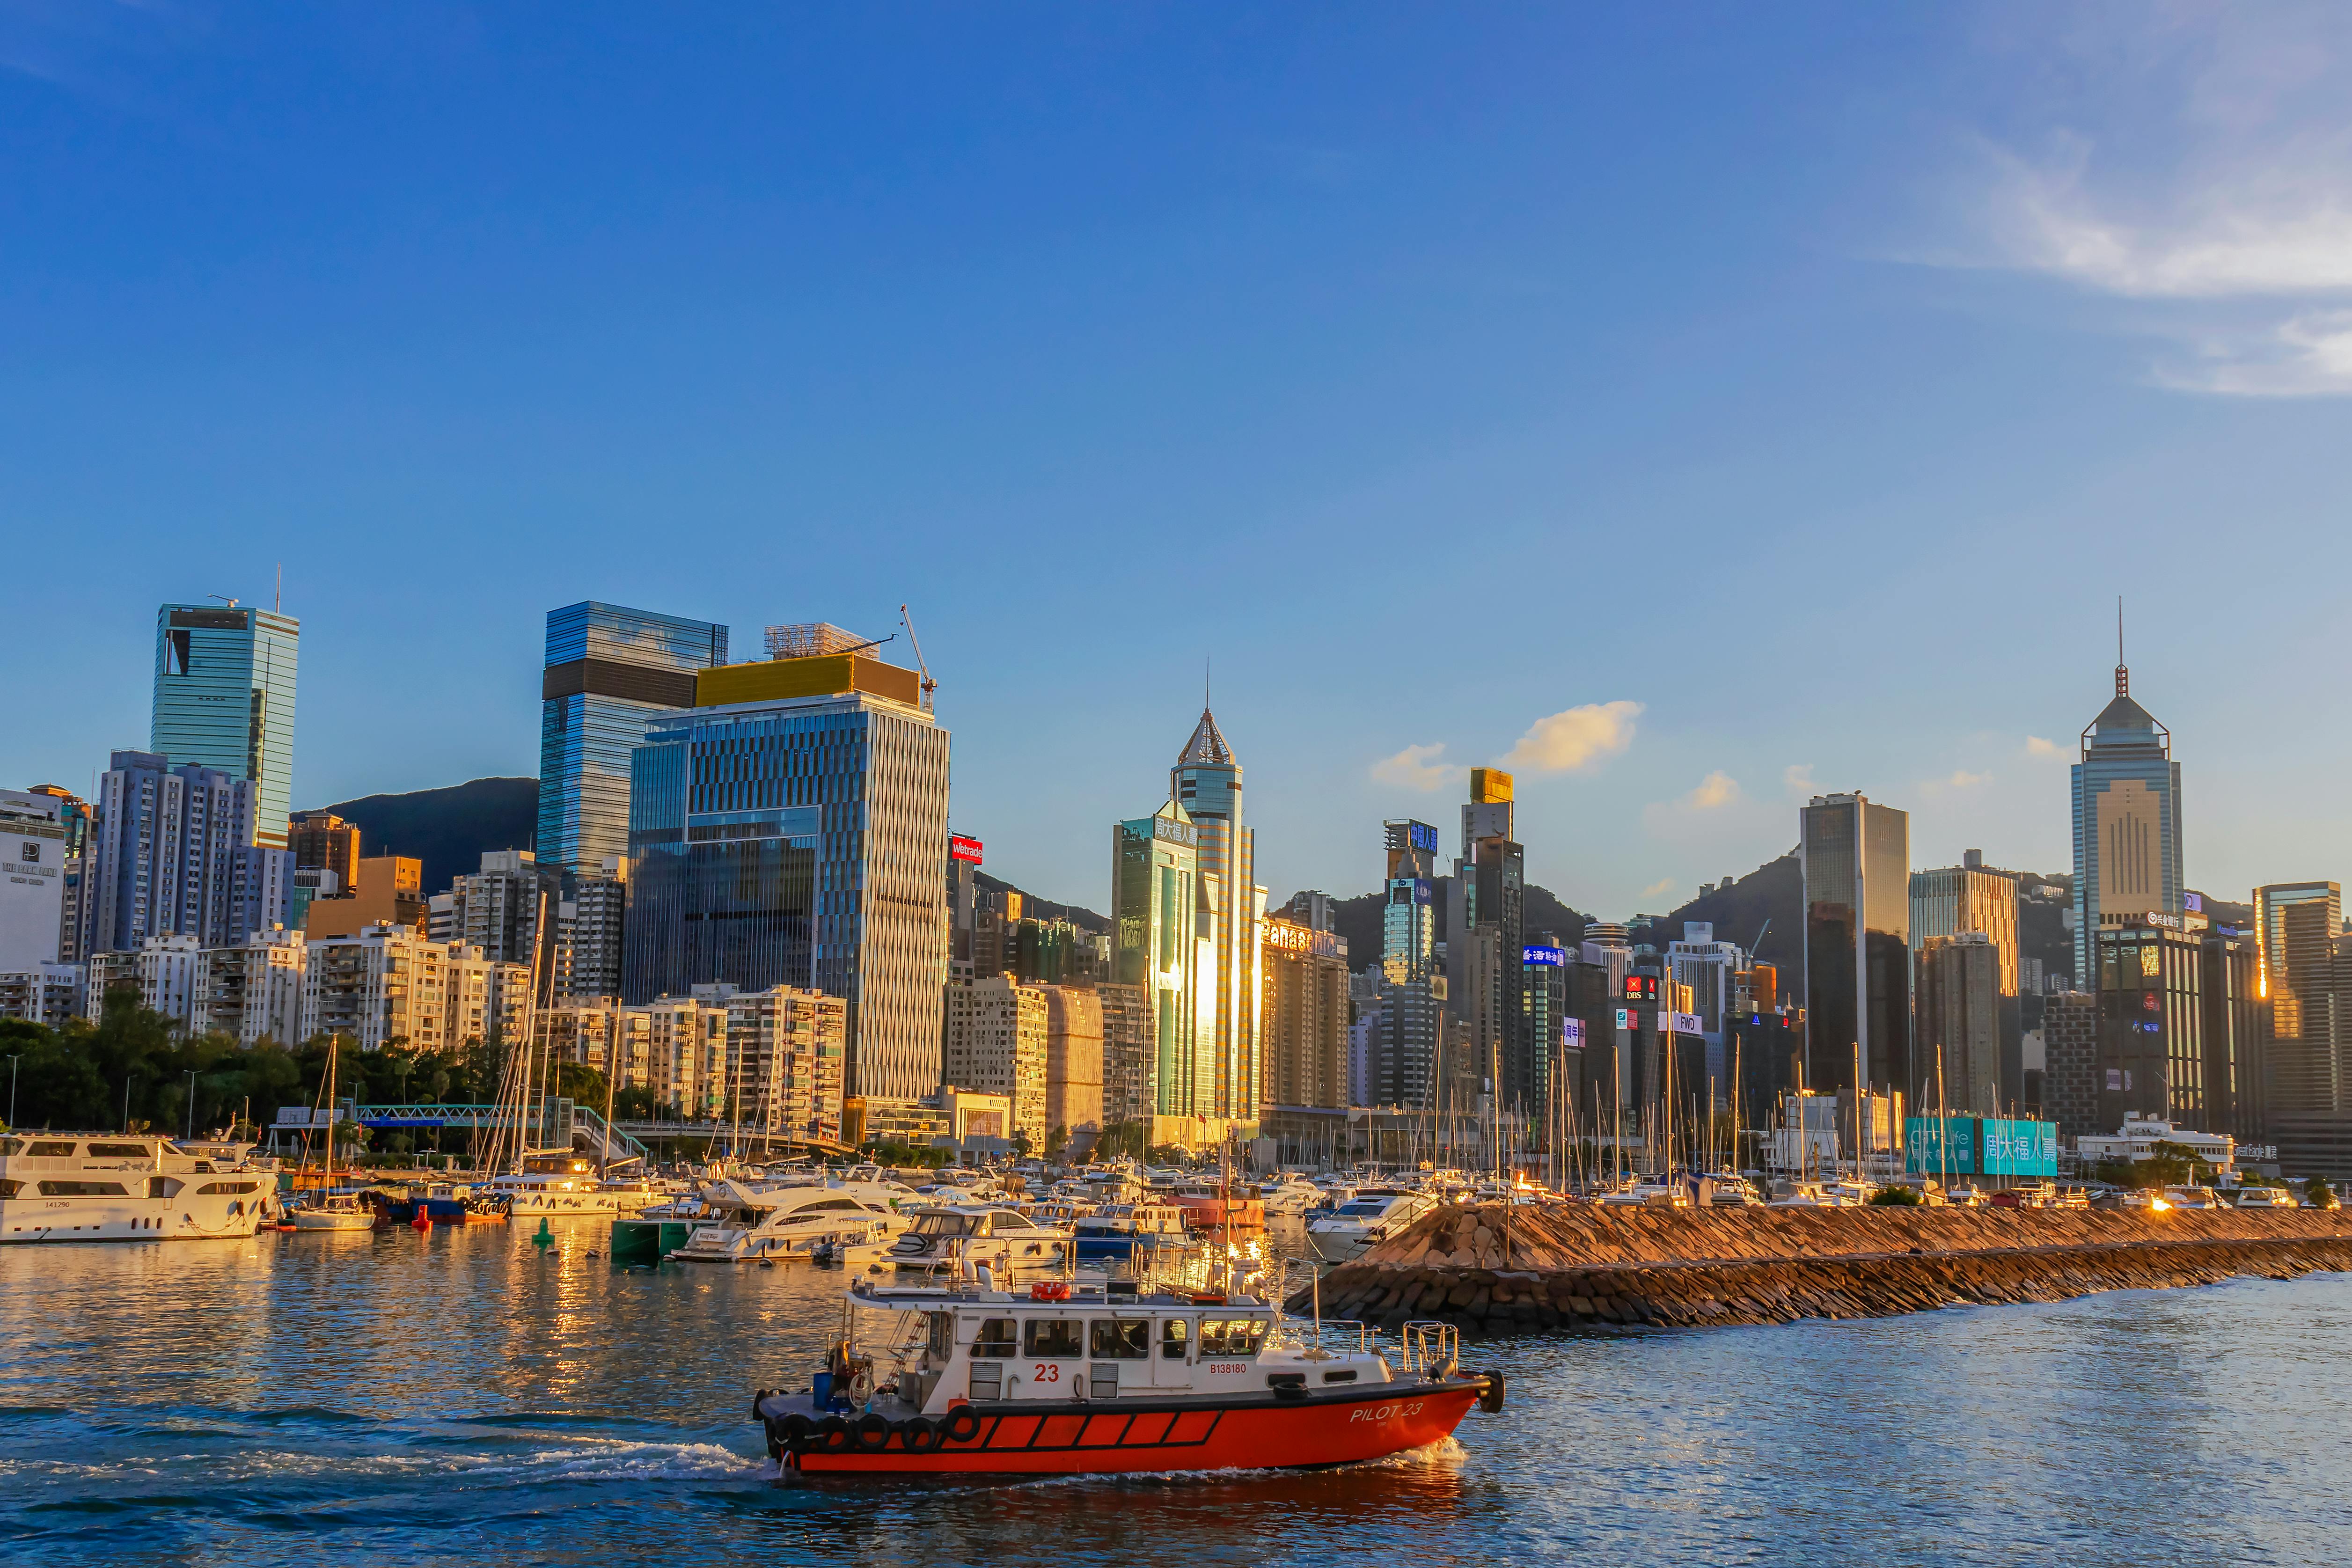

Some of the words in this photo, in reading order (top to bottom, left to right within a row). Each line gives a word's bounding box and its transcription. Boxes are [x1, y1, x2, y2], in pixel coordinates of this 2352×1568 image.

[1155, 818, 1198, 845] 周大福人壽
[1411, 822, 1437, 853] 中国人寿
[3, 863, 16, 872] THE
[19, 864, 37, 875] PARK
[39, 867, 57, 877] LANE
[1261, 916, 1335, 958] Panasonic
[1681, 1016, 1694, 1030] FWD
[1986, 1135, 2057, 1162] 周大福人壽
[1034, 1363, 1059, 1382] 23
[1210, 1363, 1246, 1374] B138180
[1350, 1405, 1402, 1423] PILOT
[1401, 1403, 1423, 1416] 23
